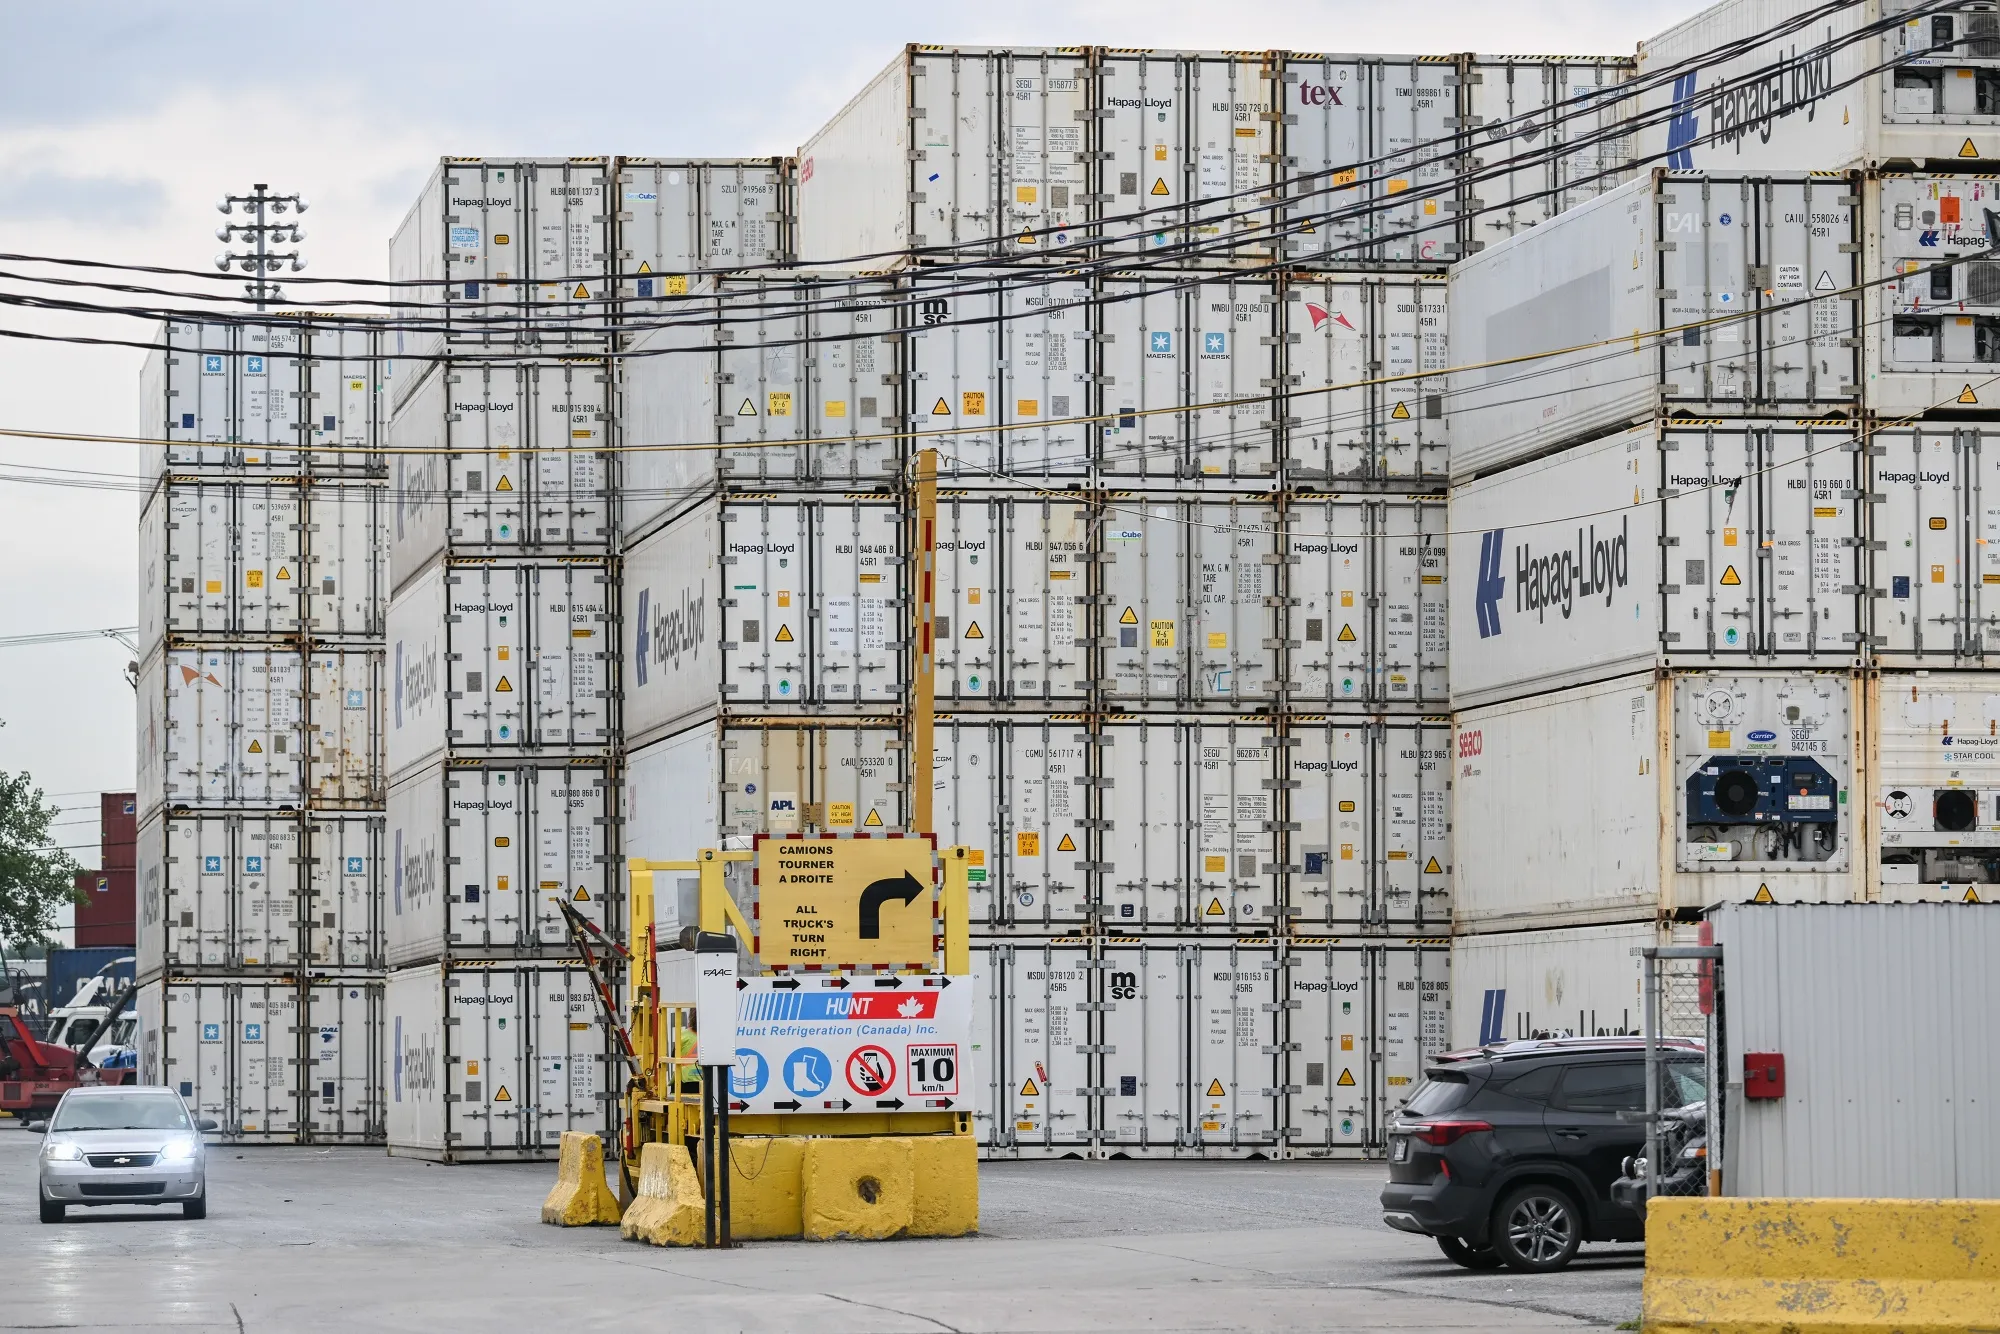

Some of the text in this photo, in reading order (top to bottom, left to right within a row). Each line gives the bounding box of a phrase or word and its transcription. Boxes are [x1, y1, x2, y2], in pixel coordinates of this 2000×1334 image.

[1016, 80, 1032, 89] SEGU
[1049, 80, 1072, 89] 915877
[1016, 92, 1031, 101] 45R1
[1299, 79, 1343, 106] tex
[1395, 88, 1413, 97] TEMU
[1416, 89, 1441, 97] 989861
[1213, 103, 1229, 111] HLBU
[1235, 103, 1247, 112] 950
[1250, 103, 1262, 112] 729
[1417, 100, 1433, 108] 45R1
[1235, 113, 1251, 121] 45R1
[721, 185, 737, 194] SZLU
[743, 198, 758, 206] 45R1
[1785, 214, 1804, 223] CAIU
[1811, 213, 1840, 223] 558026
[711, 229, 724, 238] TARE
[1812, 228, 1830, 237] 45R1
[711, 238, 721, 247] NET
[1212, 303, 1229, 312] MNBU
[1235, 304, 1248, 312] 029
[1250, 304, 1262, 313] 050
[1397, 304, 1445, 313] SUDU 617331
[855, 314, 872, 323] 45R1
[1235, 313, 1251, 322] 45R1
[1420, 318, 1437, 326] 45R1
[1787, 480, 1807, 489] HLBU
[1813, 480, 1827, 489] 619
[1829, 480, 1843, 489] 660
[1814, 490, 1832, 499] 45R1
[1237, 538, 1254, 547] 45R1
[835, 545, 853, 554] HLBU
[859, 558, 877, 566] 45R1
[1516, 514, 1627, 624] Hapag-Lloyd
[1155, 639, 1169, 647] HIGH
[1791, 730, 1810, 739] SEGU
[1459, 729, 1482, 758] seaco
[1791, 742, 1817, 751] 942145
[1957, 738, 1998, 746] Hapag-Lloyd
[1025, 750, 1043, 758] CGMU
[1049, 750, 1073, 758] 561717
[1203, 749, 1220, 758] SEGU
[1236, 749, 1260, 758] 962876
[1049, 765, 1066, 773] 45R1
[1203, 761, 1219, 770] 45R1
[771, 800, 796, 811] APL
[779, 846, 833, 855] CAMIONS
[778, 860, 834, 869] TOURNER
[779, 875, 834, 883] A DROITE
[796, 905, 817, 914] ALL
[784, 920, 834, 928] TRUCK'S
[792, 934, 825, 943] TURN
[790, 948, 826, 957] RIGHT
[1213, 972, 1232, 981] MSDU
[1235, 972, 1261, 981] 916153
[1235, 984, 1253, 993] 45R5
[826, 997, 873, 1015] HUNT
[736, 1024, 938, 1037] Hunt Refrigeration (Canada) Inc.
[910, 1048, 954, 1057] MAXIMUM
[911, 1057, 954, 1082] 10
[921, 1083, 944, 1093] km/h
